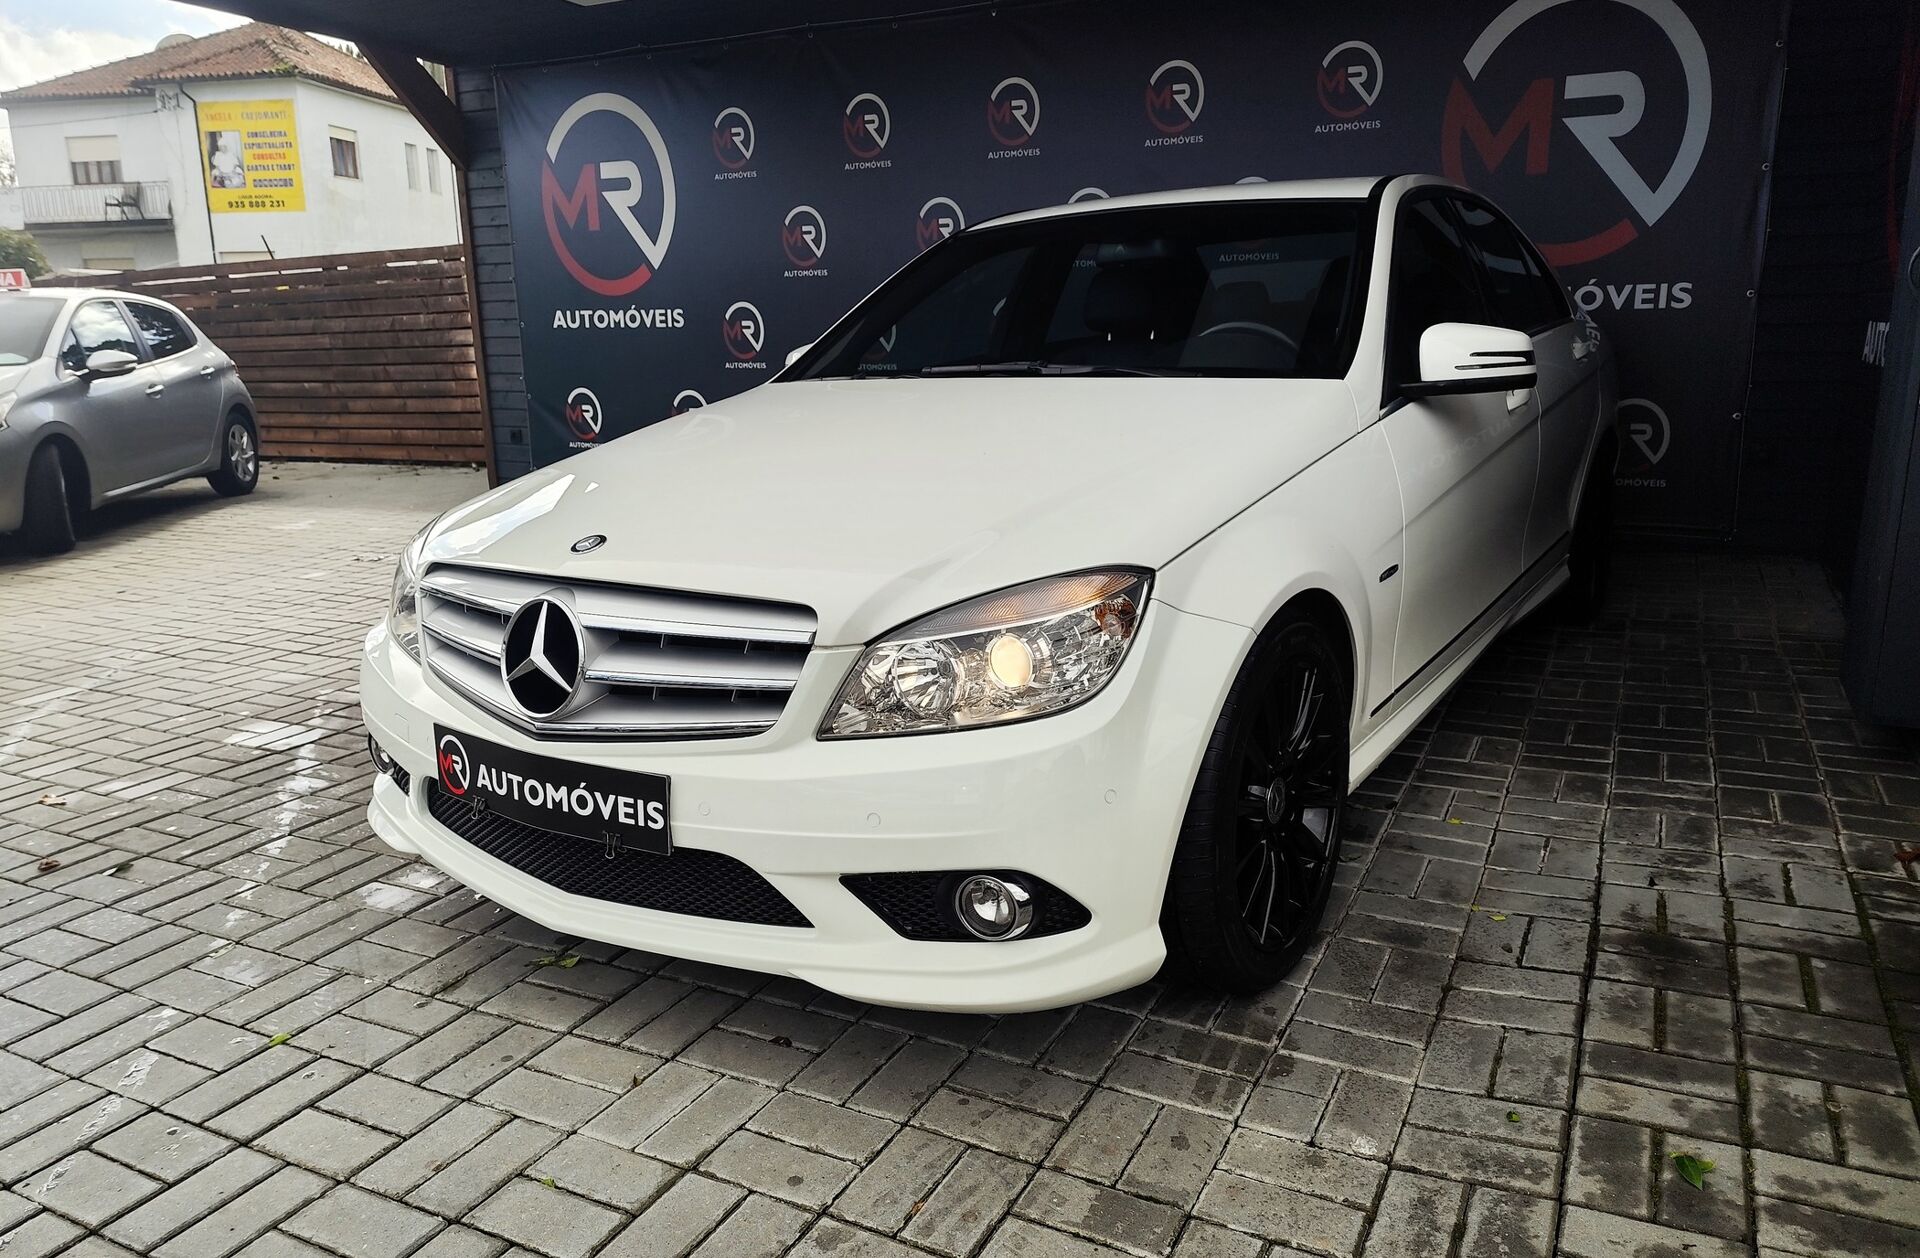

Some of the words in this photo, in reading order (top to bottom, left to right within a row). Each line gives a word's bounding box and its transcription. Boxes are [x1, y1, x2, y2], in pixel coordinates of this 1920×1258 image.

[1314, 119, 1381, 134] AUTOMÓVEIS
[1144, 134, 1204, 147] AUTOMÓVEIS
[987, 148, 1040, 159] AUTOMÓVEIS
[844, 159, 892, 171] AUTOMÓVEIS
[714, 170, 757, 180] AUTOMÓVEIS
[227, 200, 246, 208] 935
[269, 199, 286, 208] 231
[784, 268, 828, 278] AUTOMÓVEIS
[1572, 278, 1693, 311] ÓVEIS
[552, 304, 685, 329] AUTOMÓVEIS
[725, 361, 767, 369] AUTOMÓVEIS
[476, 762, 665, 831] AUTOMÓVEIS
